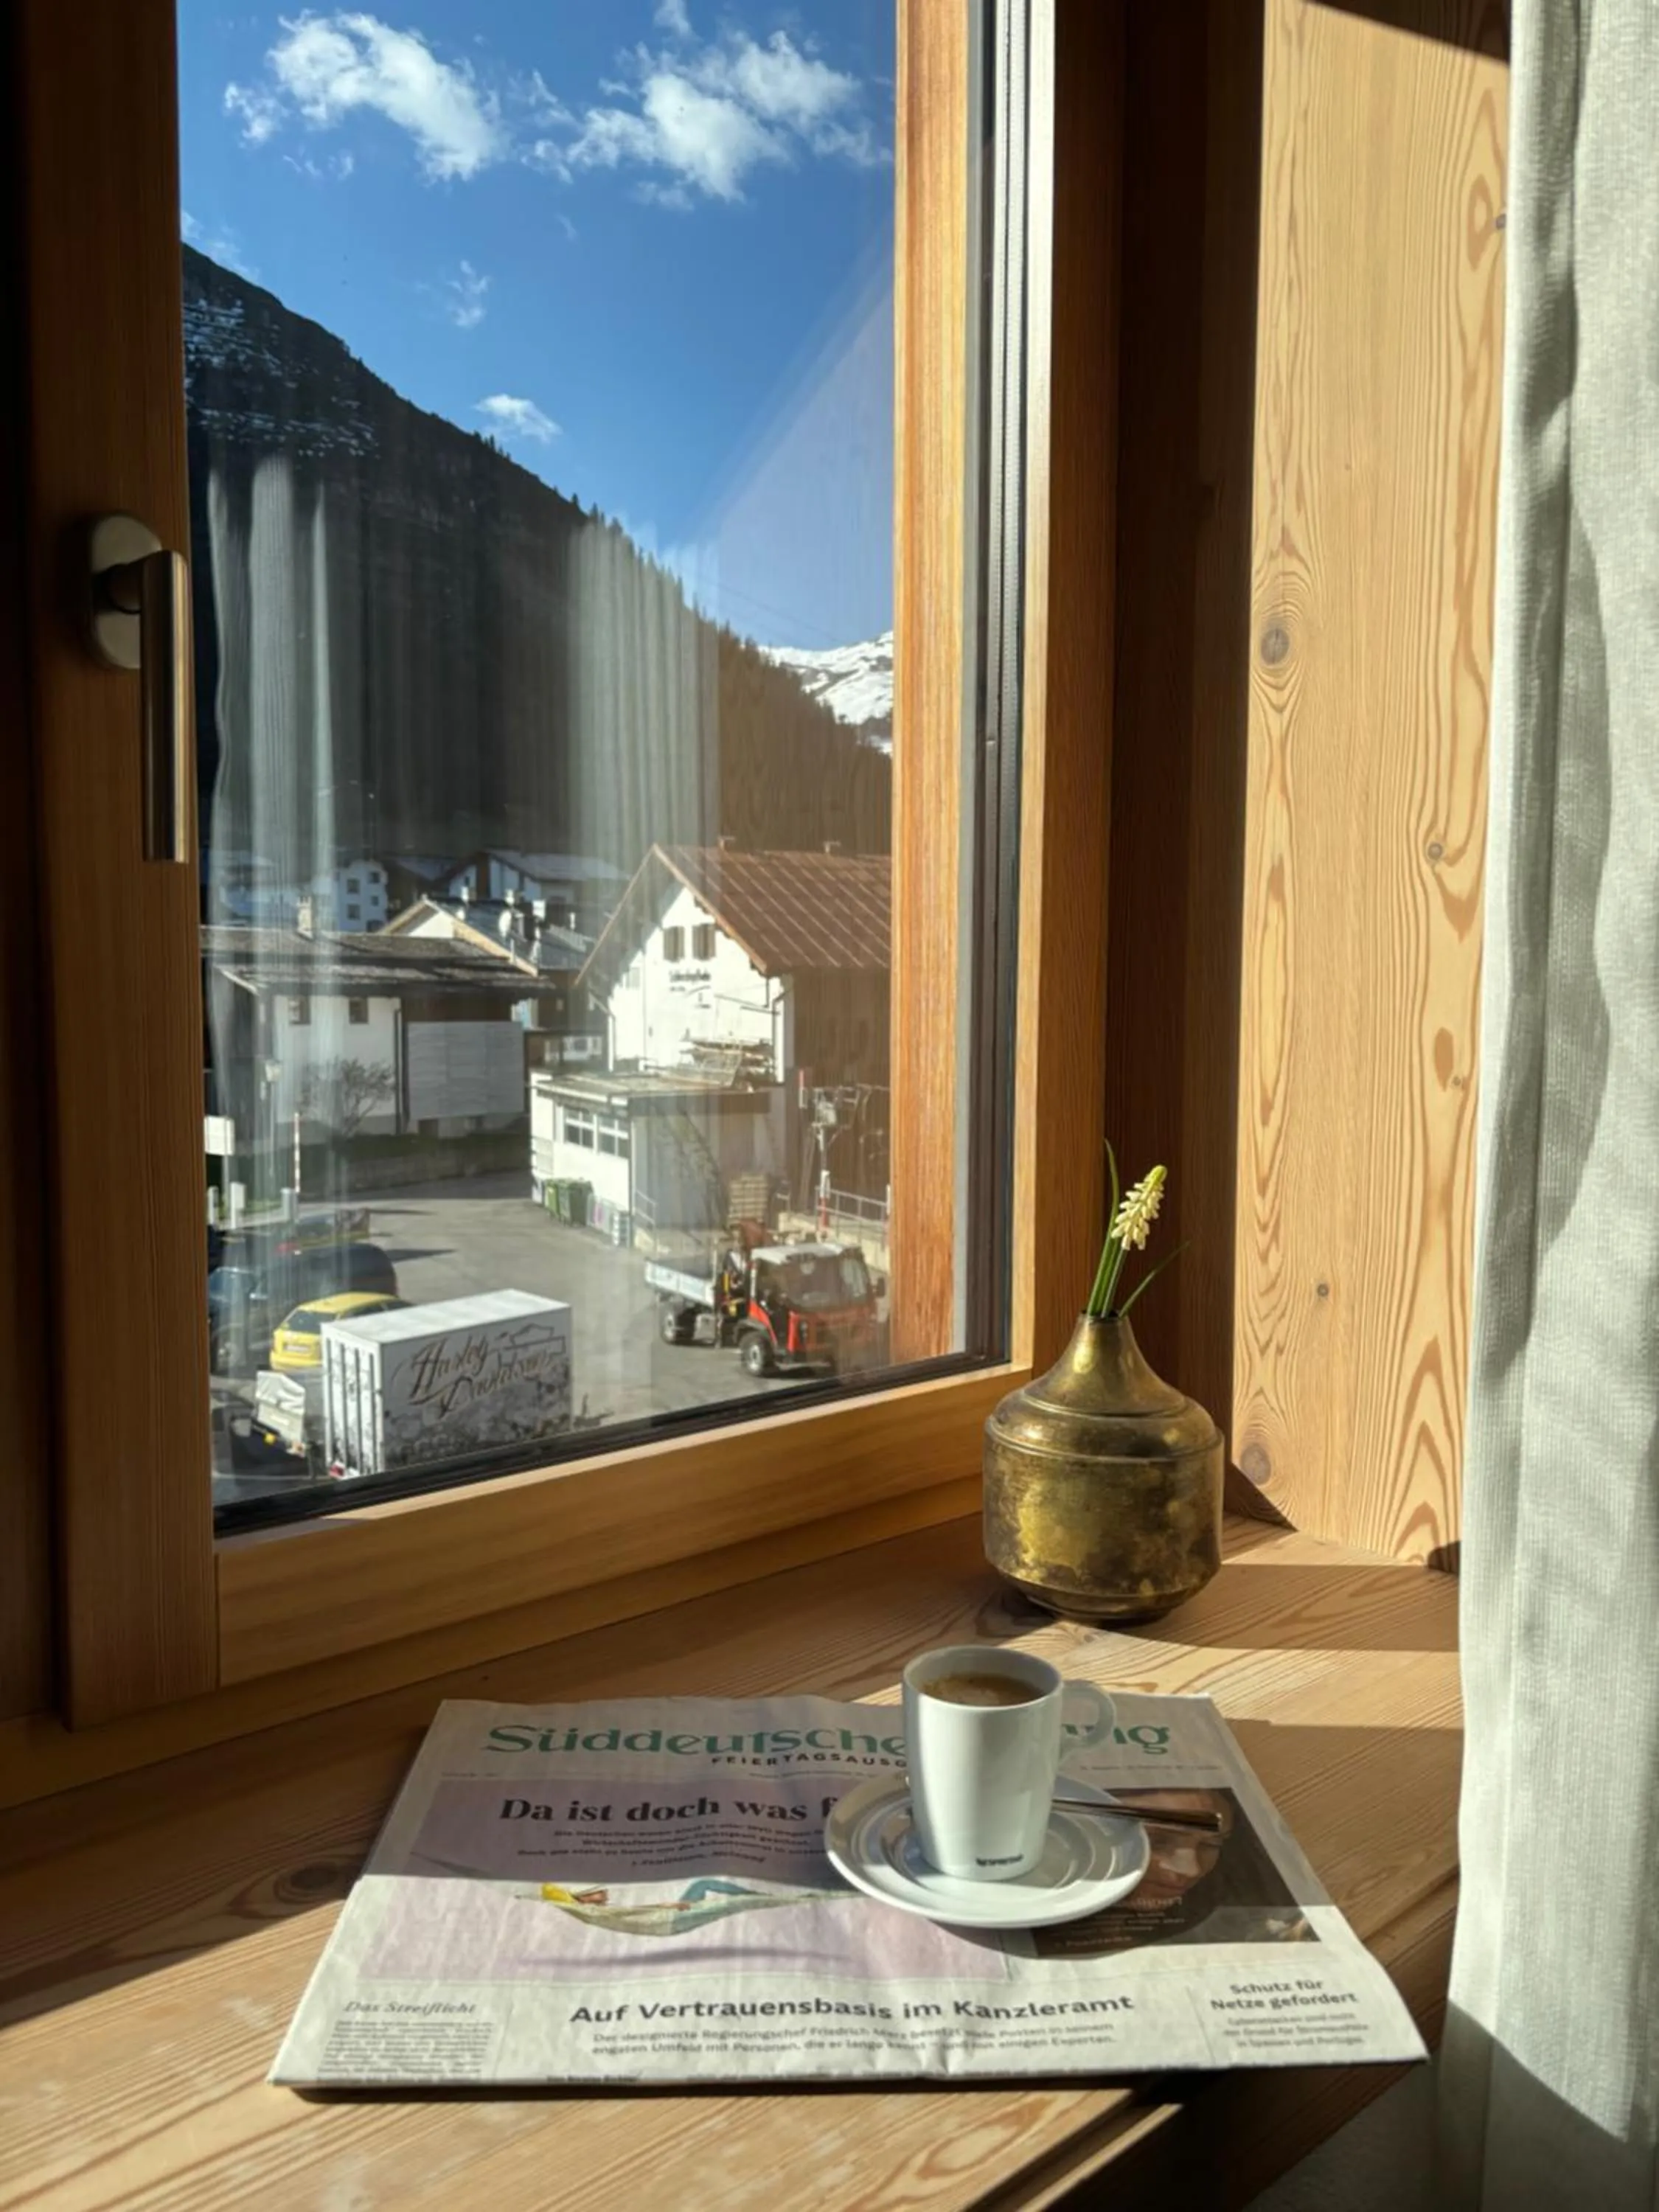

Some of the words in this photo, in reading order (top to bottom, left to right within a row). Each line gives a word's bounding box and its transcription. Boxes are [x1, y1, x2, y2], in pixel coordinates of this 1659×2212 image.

[481, 1725, 906, 1756] Süddeutsche
[712, 1753, 908, 1768] FEIERTAGSAUSG
[500, 1798, 554, 1820] Da
[567, 1800, 611, 1822] ist
[625, 1797, 720, 1821] doch
[733, 1799, 807, 1821] was
[1230, 1982, 1291, 1994] Schutz
[1296, 1980, 1323, 1992] für
[342, 2000, 380, 2013] Das
[570, 2005, 628, 2023] Auf
[639, 1998, 891, 2020] Vertrauensbasis
[903, 2002, 941, 2019] im
[953, 1995, 1134, 2020] Kanzleramt
[1211, 1999, 1265, 2011] Netze
[1270, 1993, 1357, 2010] gefordert
